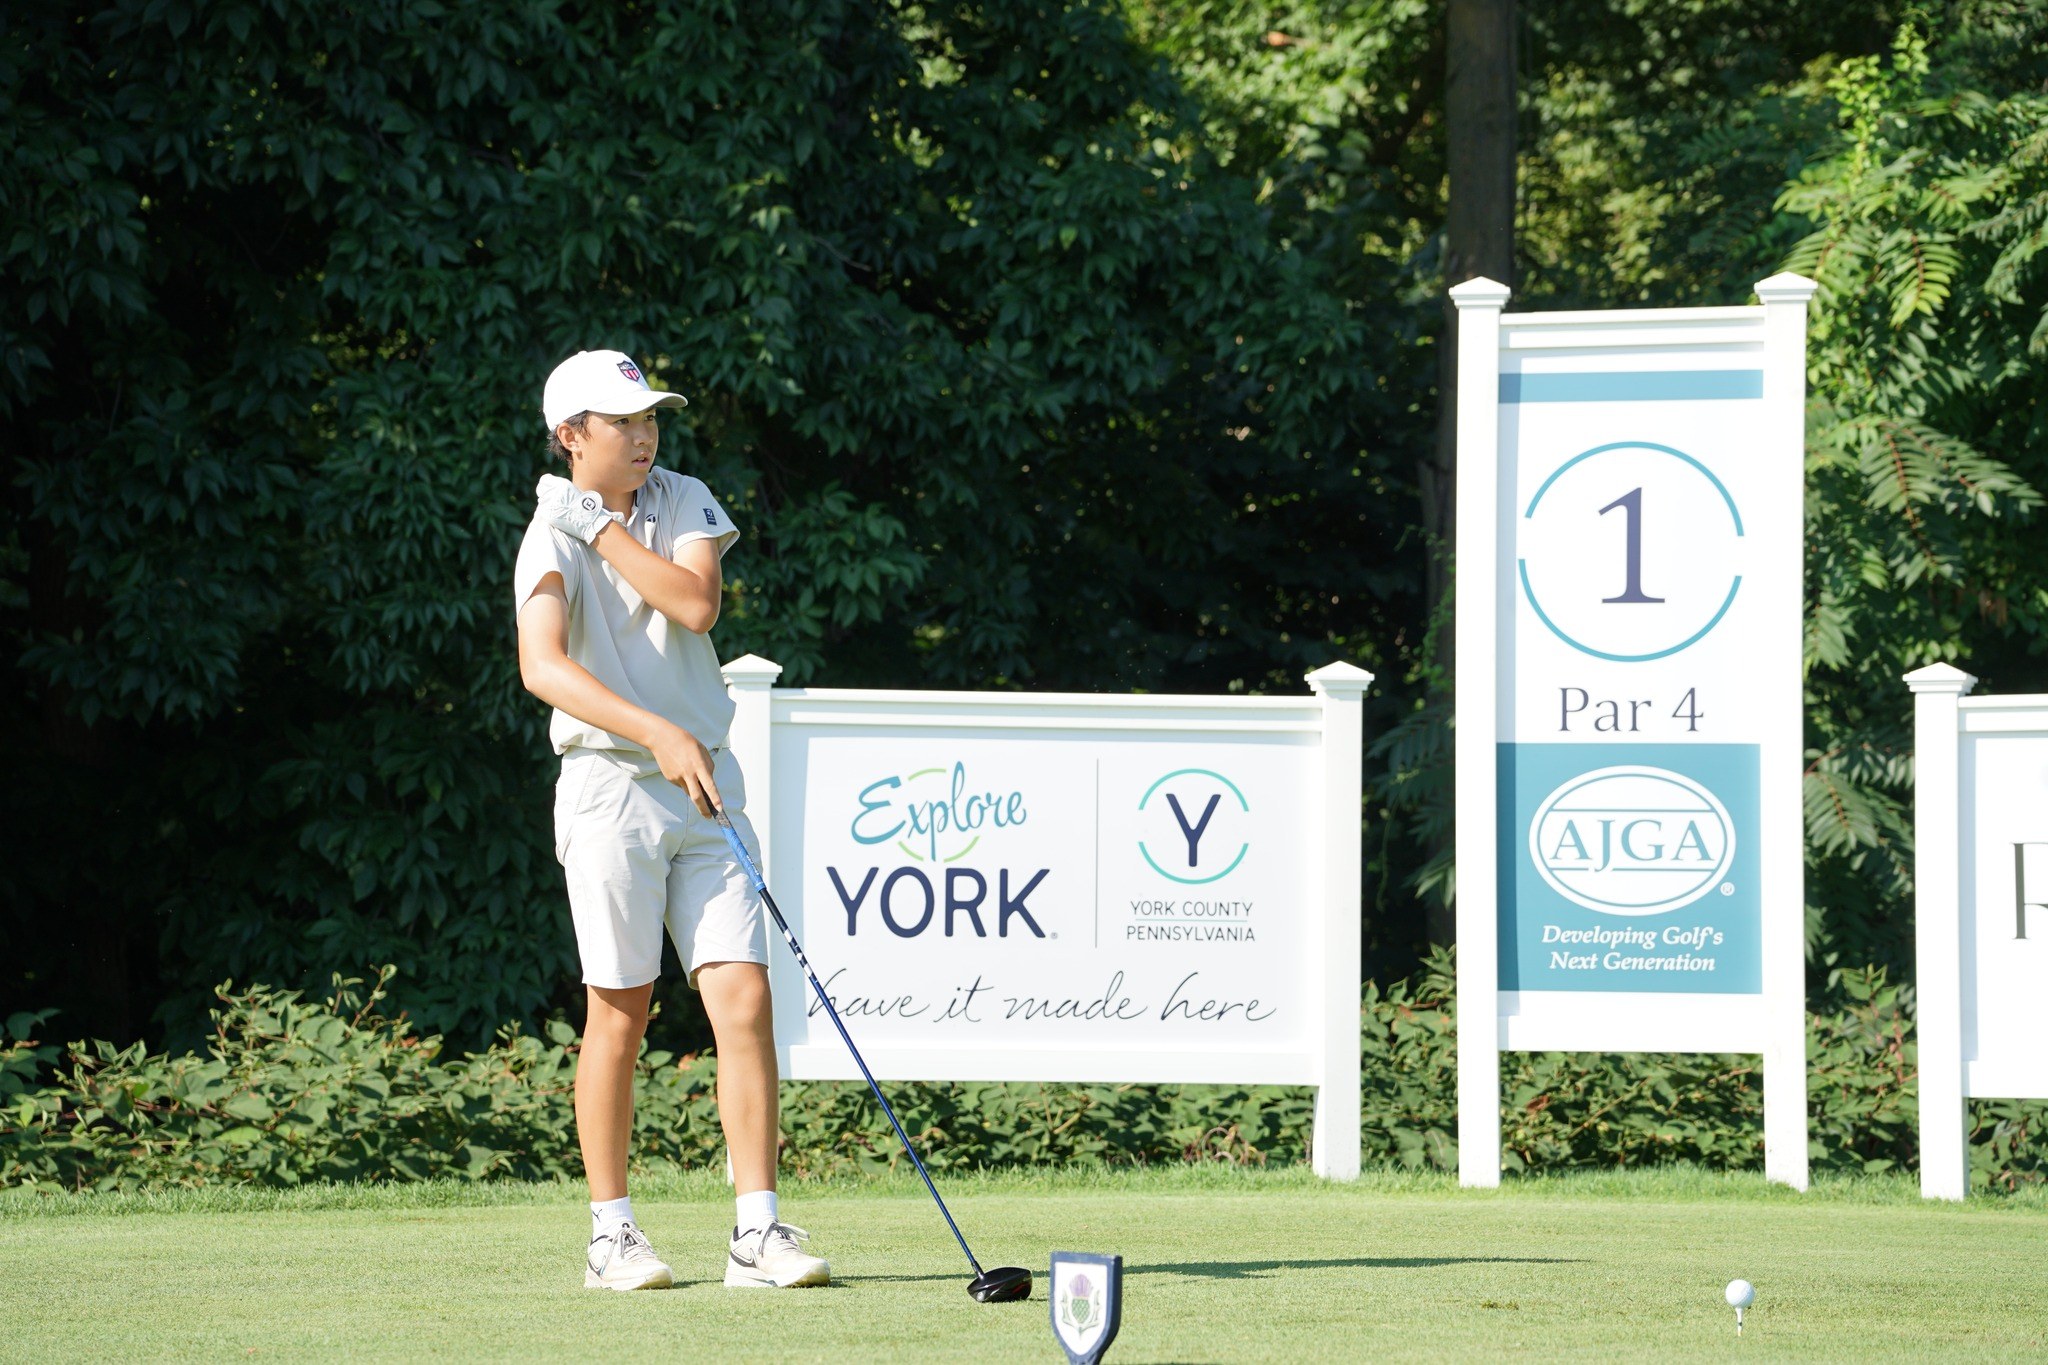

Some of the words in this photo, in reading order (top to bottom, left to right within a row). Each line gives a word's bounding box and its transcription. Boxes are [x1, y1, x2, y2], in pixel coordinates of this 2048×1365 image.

[1597, 486, 1666, 604] 1
[1558, 687, 1652, 733] Par
[1671, 686, 1705, 732] 4
[850, 760, 1027, 862] Explore
[1165, 793, 1222, 867] Y
[1550, 819, 1714, 872] AJGA
[826, 865, 1051, 939] YORK
[1130, 900, 1176, 917] YORK
[1182, 900, 1253, 917] COUNTY
[1126, 925, 1256, 942] PENNSYLVANIA
[1541, 925, 1658, 951] Developing
[1662, 926, 1724, 949] Golf's
[1549, 951, 1599, 970] Next
[1602, 951, 1715, 971] Generation
[807, 968, 930, 1021] have
[933, 974, 995, 1023] it
[1003, 970, 1148, 1021] made
[1160, 971, 1278, 1022] here
